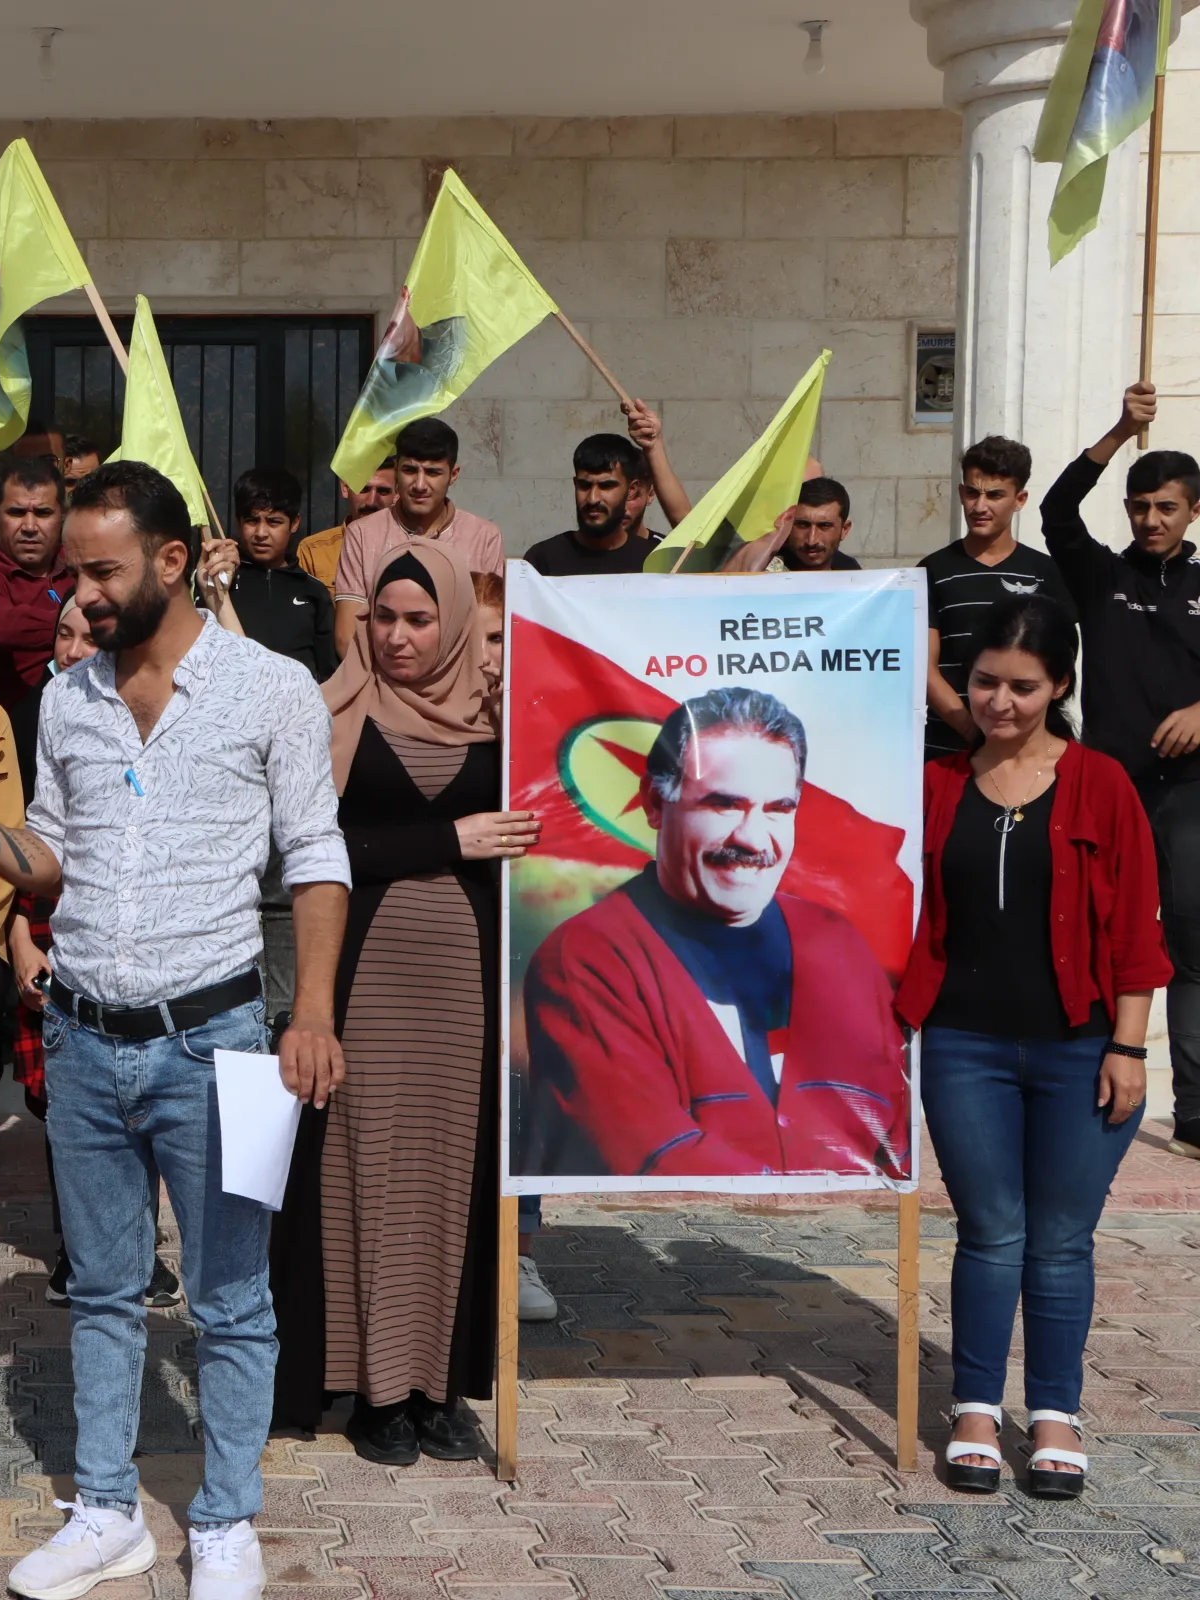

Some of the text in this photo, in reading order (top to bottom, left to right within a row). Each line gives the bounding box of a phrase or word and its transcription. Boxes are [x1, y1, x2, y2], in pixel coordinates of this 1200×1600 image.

[720, 612, 826, 641] RÊBER
[645, 648, 901, 677] APO IRADA MEYE
